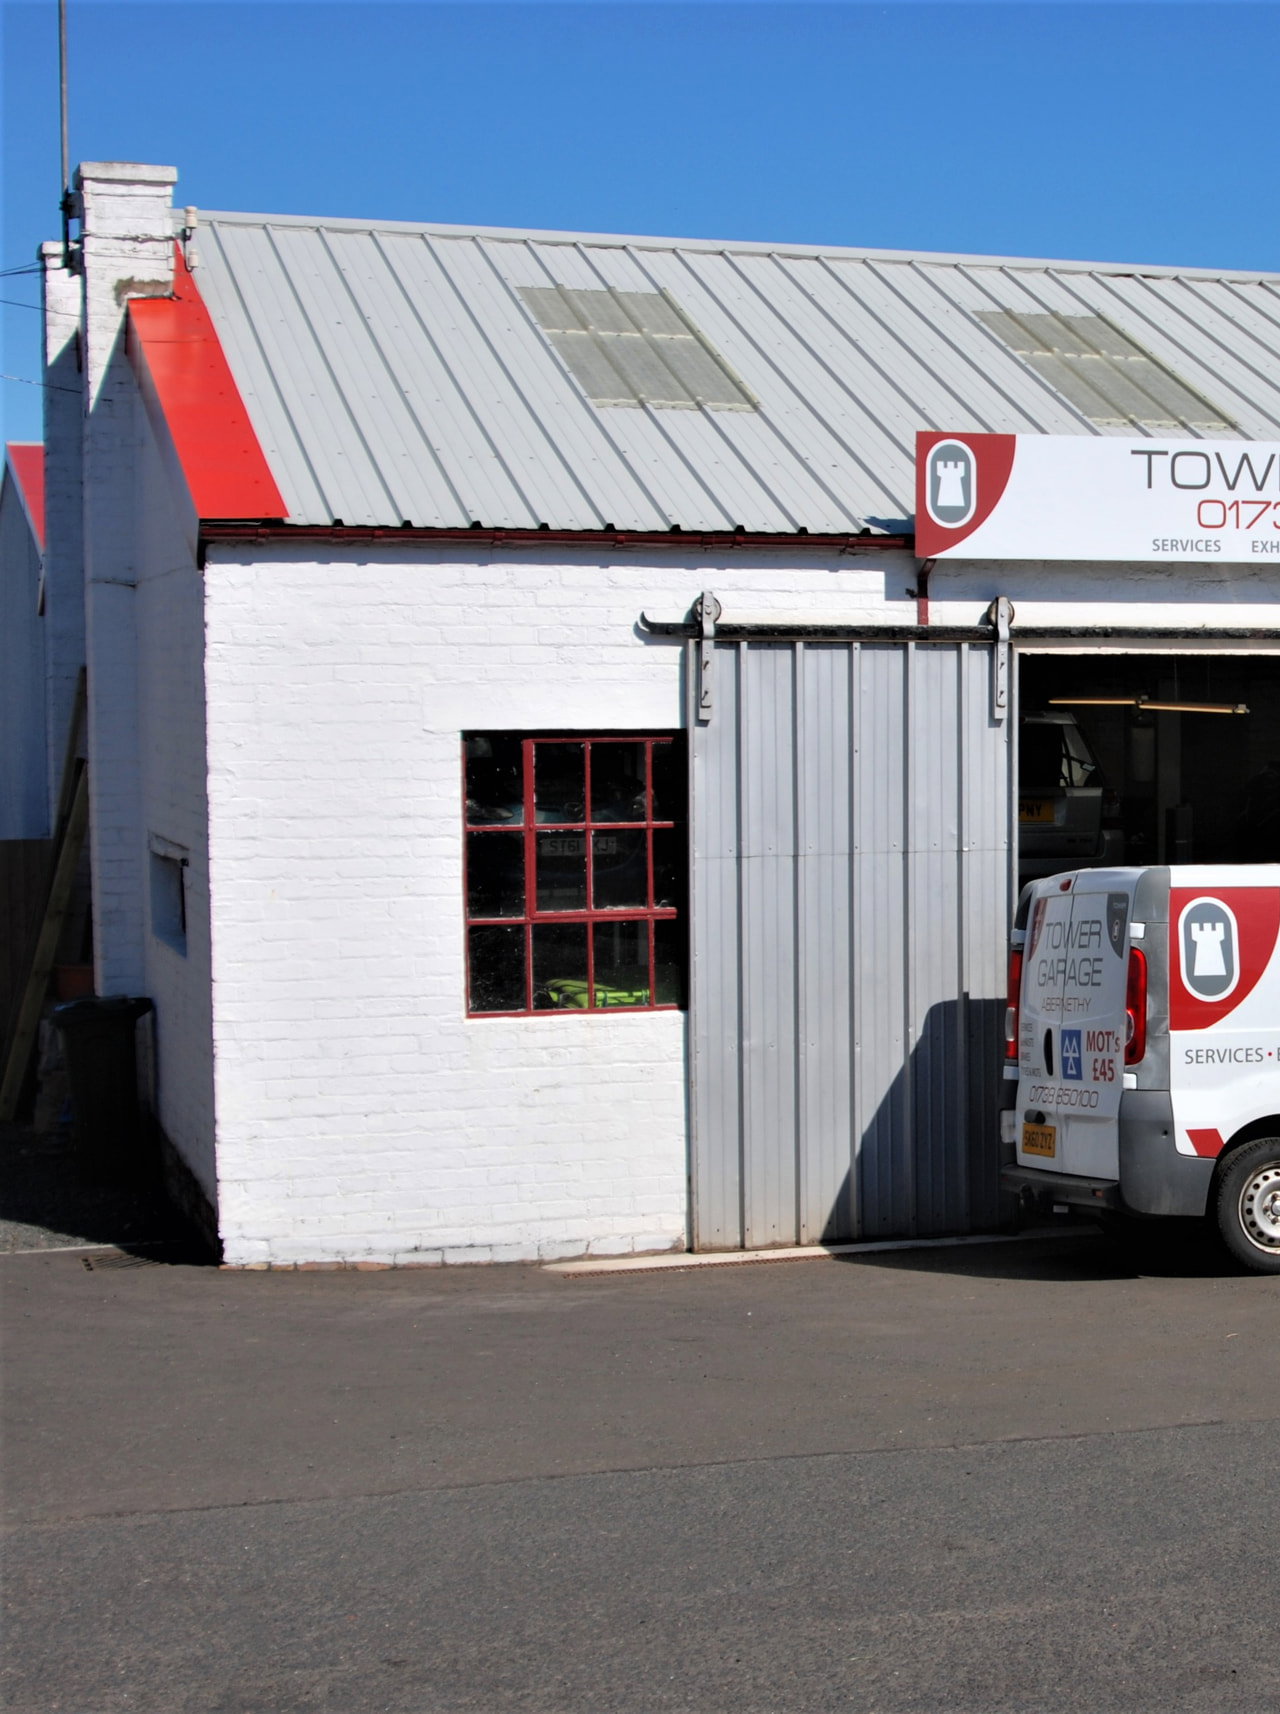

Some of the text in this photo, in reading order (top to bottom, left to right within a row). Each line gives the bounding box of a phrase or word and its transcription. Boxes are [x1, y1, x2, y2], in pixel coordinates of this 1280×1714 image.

[1152, 538, 1222, 553] SERVICES
[1045, 920, 1102, 949] TOWER
[1037, 957, 1104, 987] GARAGE
[1086, 1030, 1121, 1053] MOT's
[1184, 1047, 1264, 1065] SERVICES
[1092, 1058, 1115, 1082] £45
